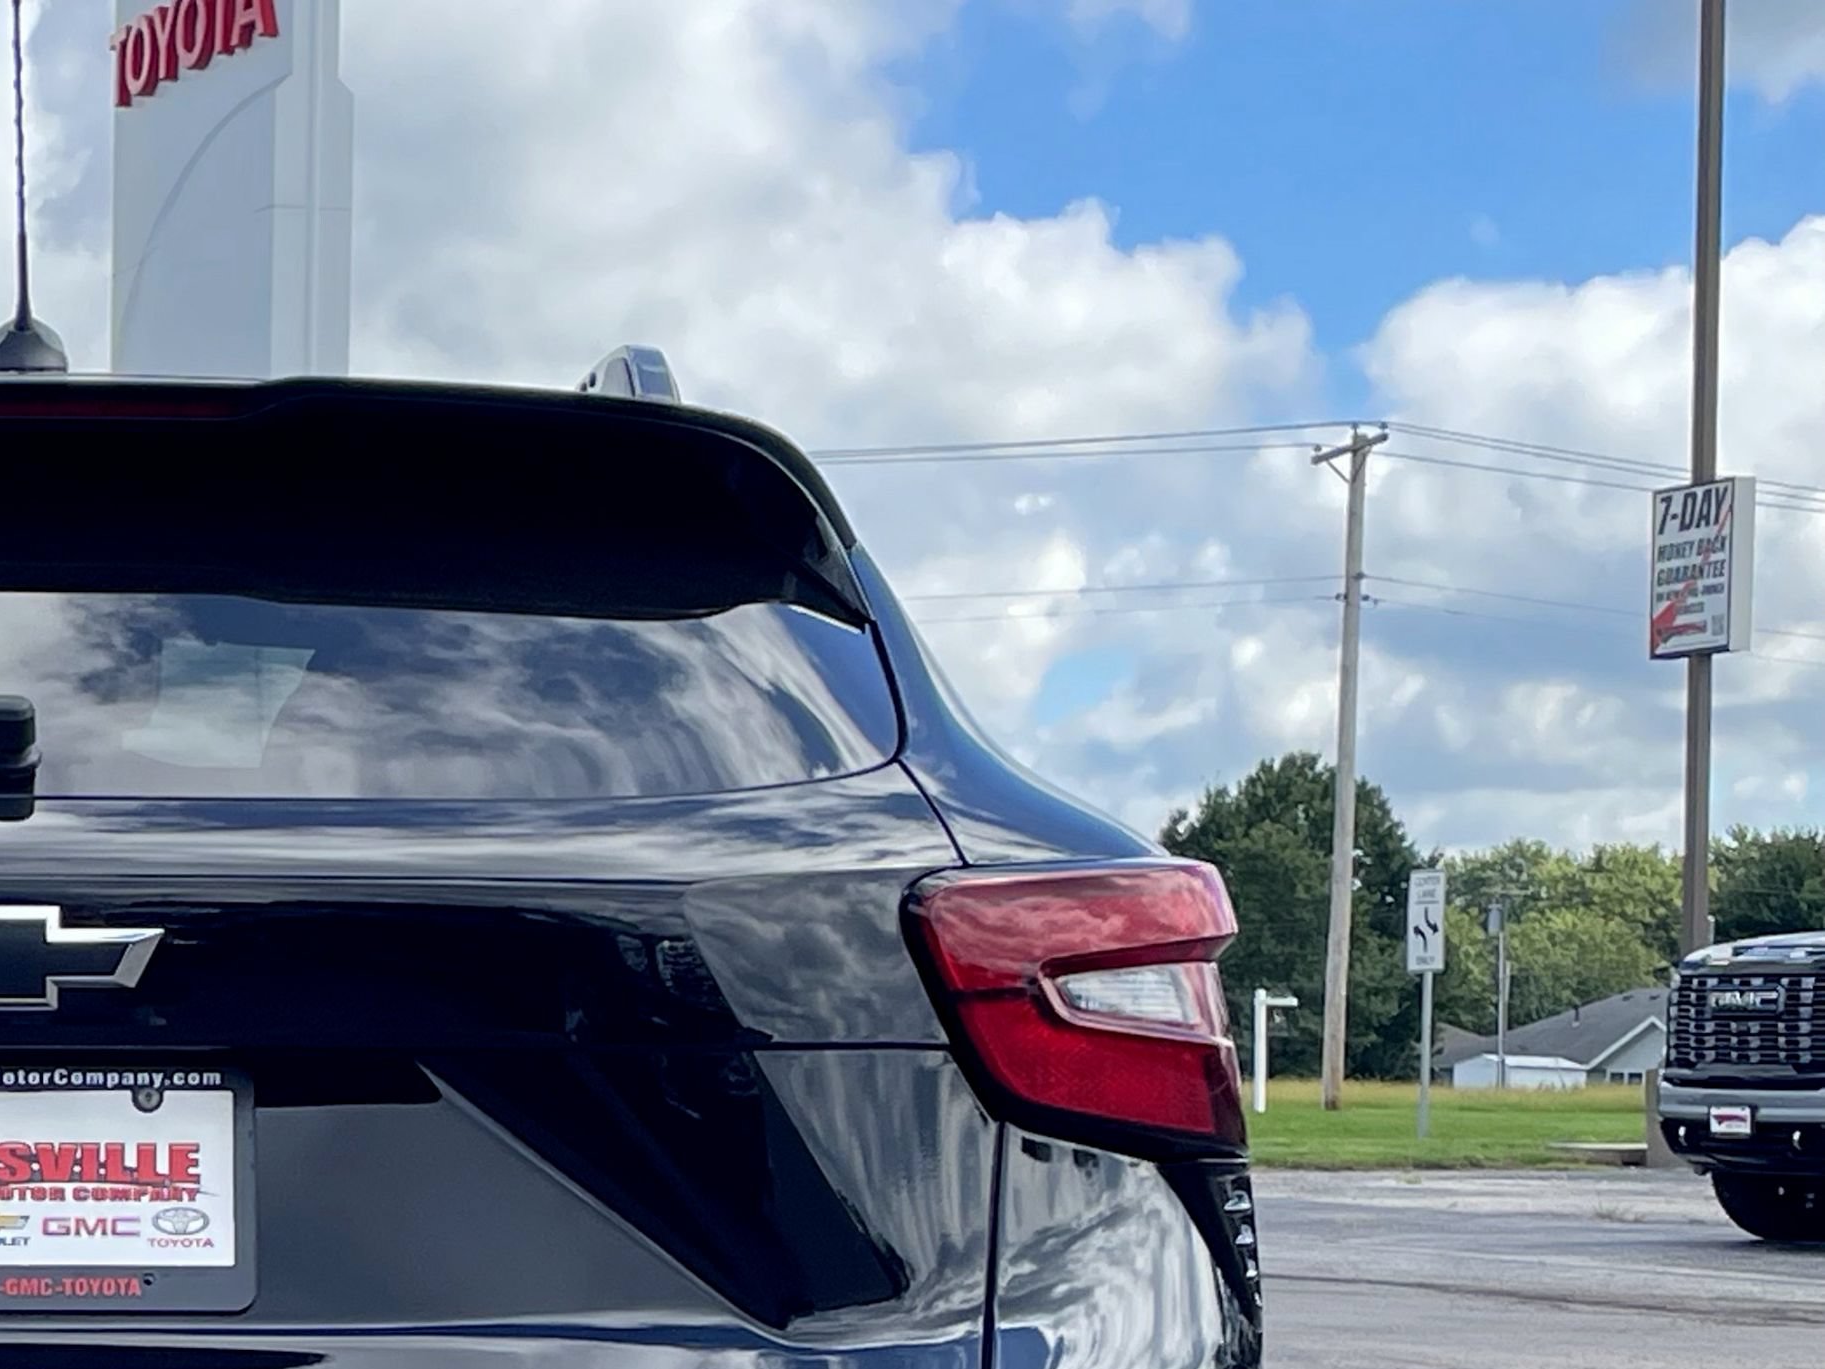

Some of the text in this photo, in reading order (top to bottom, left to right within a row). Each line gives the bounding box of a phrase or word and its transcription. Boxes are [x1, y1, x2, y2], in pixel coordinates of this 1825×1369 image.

[110, 0, 279, 107] TOYOTA
[1658, 486, 1727, 535] 7-DAY
[72, 1186, 200, 1202] COMPANY
[42, 1217, 141, 1237] GMC
[147, 1238, 215, 1248] TOYOTA
